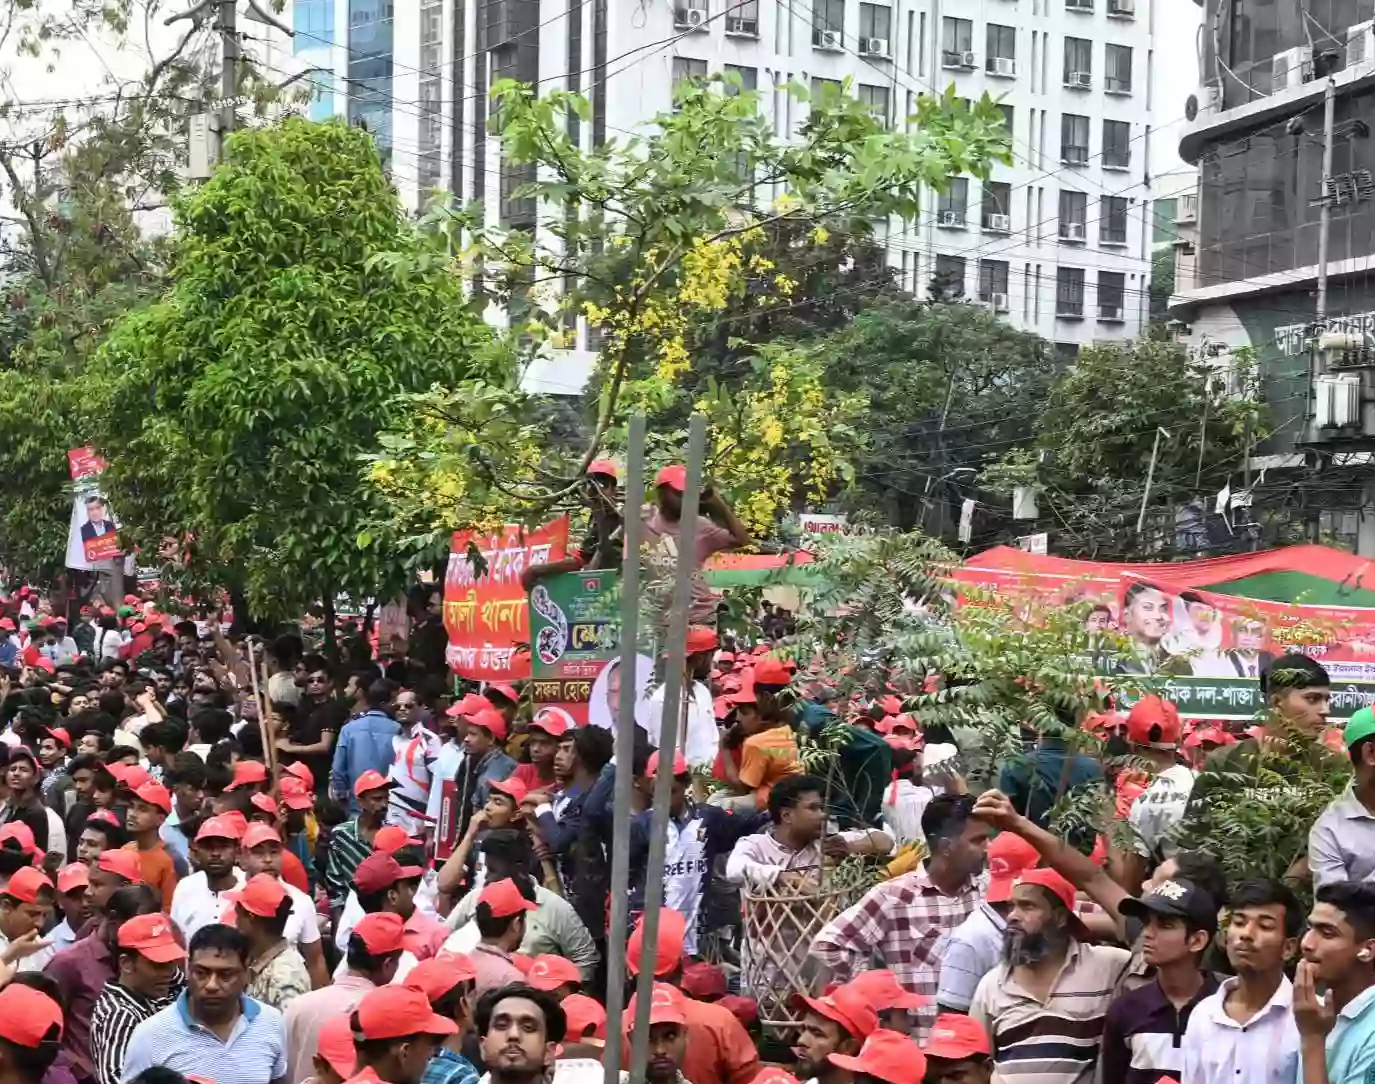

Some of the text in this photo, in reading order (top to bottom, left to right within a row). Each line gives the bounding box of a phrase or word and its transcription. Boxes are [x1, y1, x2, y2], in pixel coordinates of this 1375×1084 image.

[481, 598, 529, 633] থানা
[533, 680, 591, 702] সফল হোক
